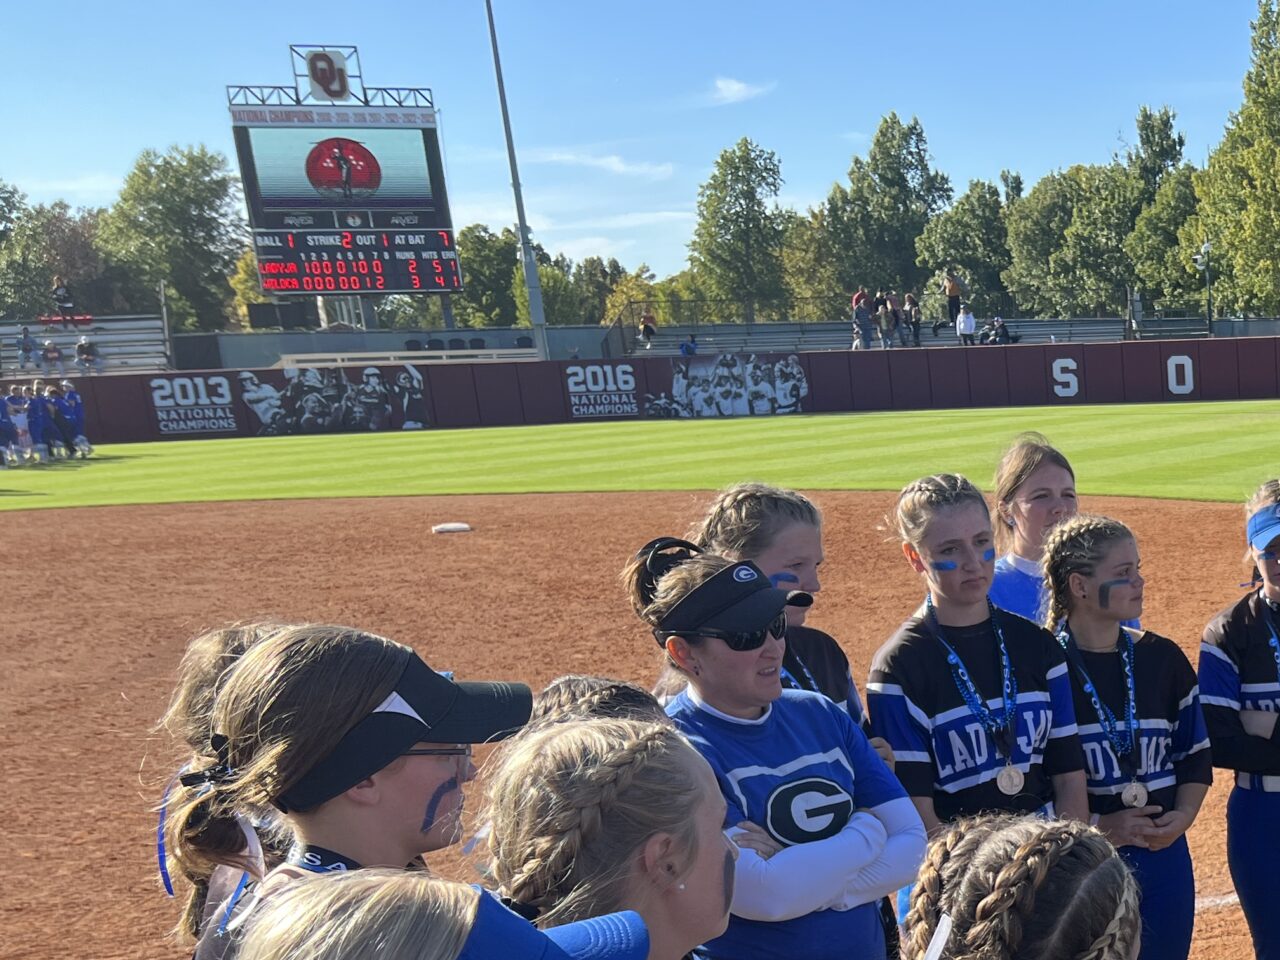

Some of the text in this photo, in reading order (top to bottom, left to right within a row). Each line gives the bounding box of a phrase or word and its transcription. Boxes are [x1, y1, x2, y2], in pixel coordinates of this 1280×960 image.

[256, 235, 283, 246] BALL
[306, 235, 341, 246] STRIKE
[342, 232, 352, 248] 2
[356, 235, 376, 245] OUT
[395, 235, 405, 244] AT
[407, 235, 425, 244] BAT
[395, 251, 415, 259] RUNS
[421, 251, 438, 259] HITS
[566, 364, 636, 393] 2016
[150, 376, 233, 407] 2013
[570, 393, 638, 406] NATIONAL
[157, 407, 234, 421] NATIONAL
[572, 403, 638, 416] CHAMPIONS
[159, 418, 237, 431] CHAMPIONS
[767, 777, 853, 848] G
